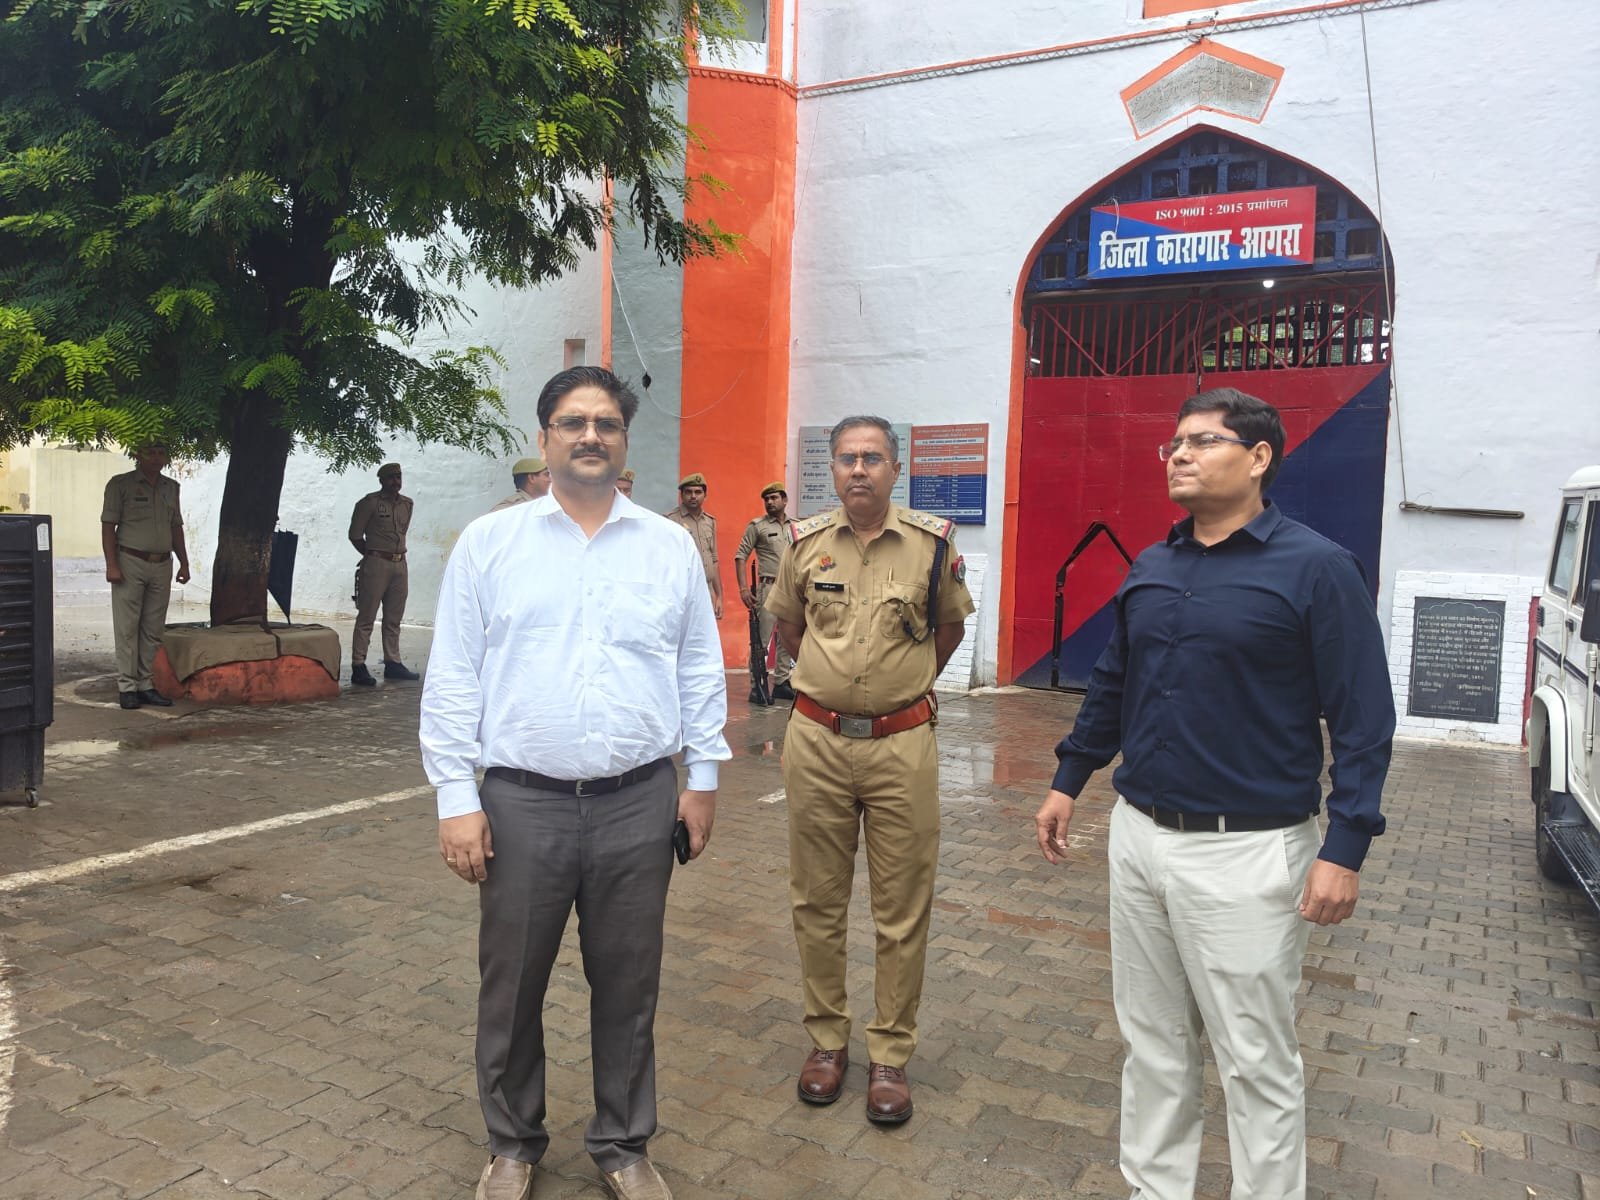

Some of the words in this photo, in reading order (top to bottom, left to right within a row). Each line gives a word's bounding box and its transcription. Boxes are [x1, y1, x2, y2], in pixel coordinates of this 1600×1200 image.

[1155, 209, 1177, 220] ISO
[1180, 206, 1205, 218] 9001
[1216, 203, 1243, 215] 2015
[1098, 230, 1151, 270] जिला
[1155, 229, 1232, 266] कारागार
[1240, 223, 1303, 260] आगरा
